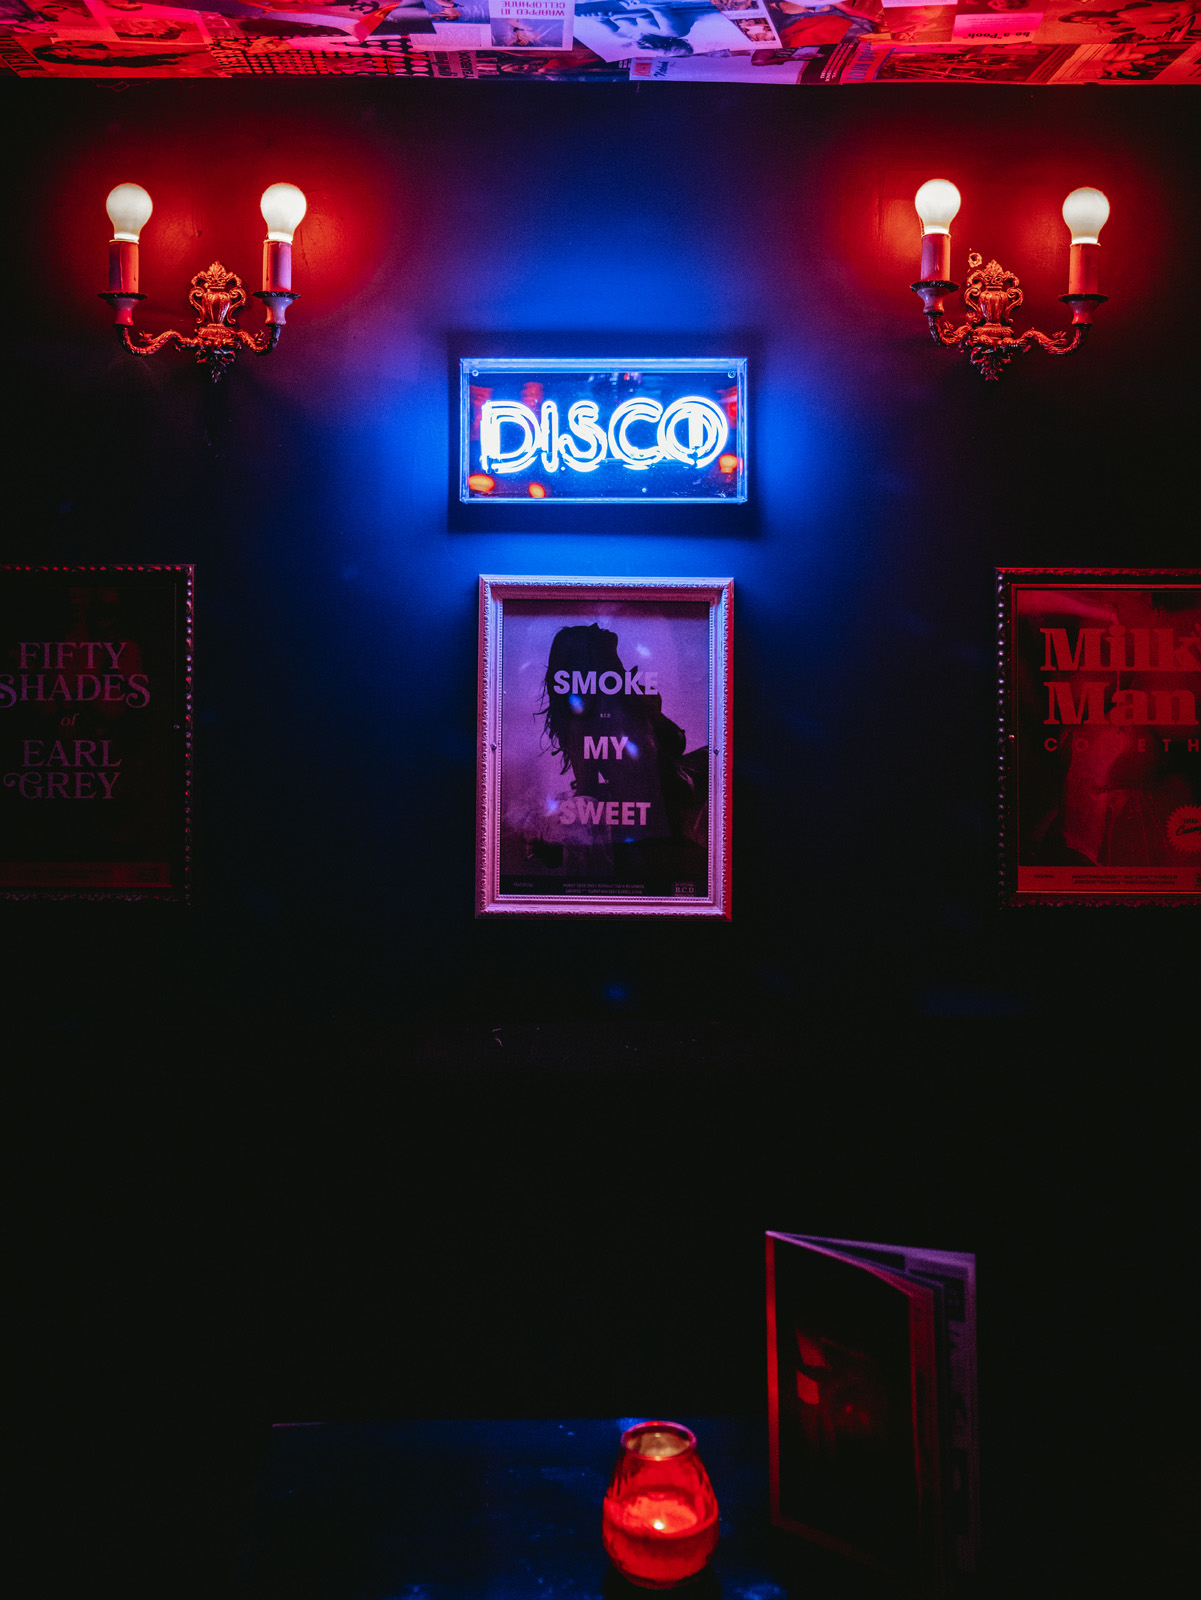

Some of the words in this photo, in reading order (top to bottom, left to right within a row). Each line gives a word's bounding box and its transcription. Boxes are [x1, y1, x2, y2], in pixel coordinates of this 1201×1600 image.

[501, 1, 566, 9] CELLOPHANE
[480, 396, 728, 473] DISCO
[17, 642, 128, 670] FIFTY
[1039, 624, 1201, 671] Milk
[0, 673, 151, 708] SHADES
[553, 670, 660, 696] SMOKE
[1043, 682, 1200, 725] Man
[60, 712, 80, 727] of
[21, 740, 122, 768] EARL
[584, 735, 629, 760] MY
[3, 771, 122, 800] GREY
[559, 801, 651, 826] SWEET
